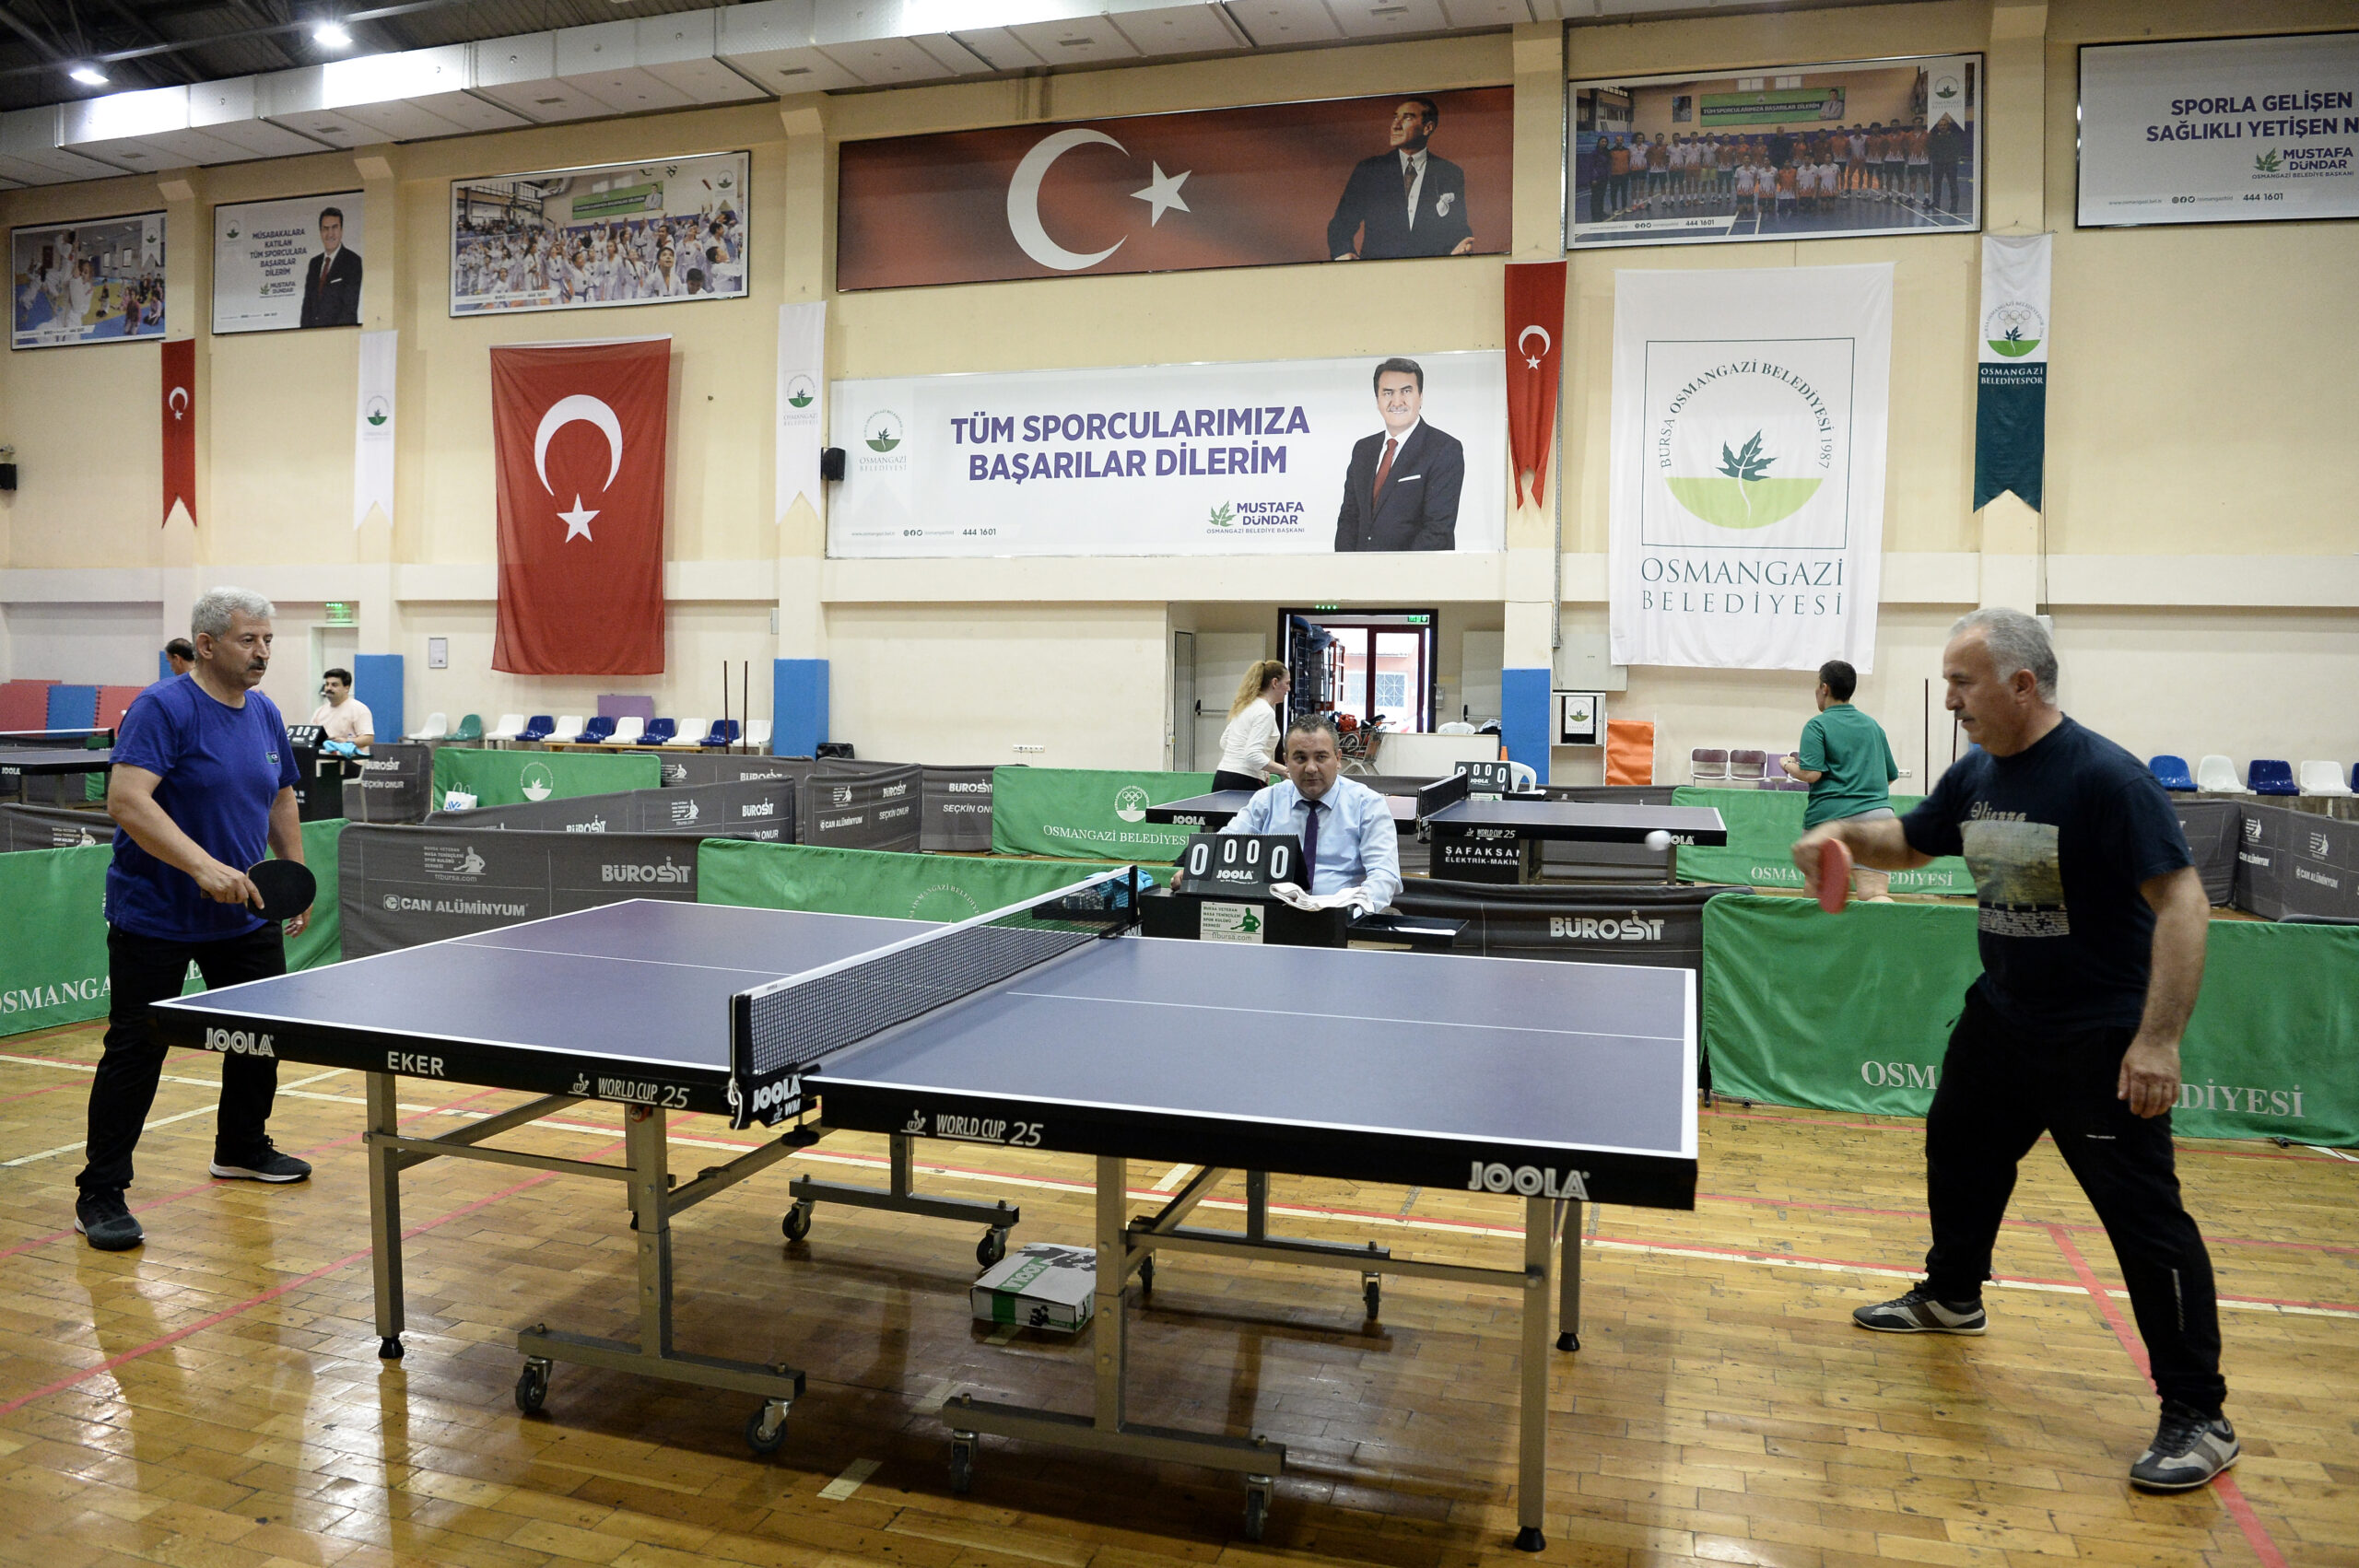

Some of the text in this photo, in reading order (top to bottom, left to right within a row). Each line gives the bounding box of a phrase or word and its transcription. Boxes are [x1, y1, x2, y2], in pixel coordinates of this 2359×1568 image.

[2171, 90, 2353, 115] SPORLA GELİŞEN
[2146, 120, 2241, 142] SAĞLIKLI
[2248, 116, 2338, 138] YETİŞEN
[2283, 147, 2353, 159] MUSTAFA
[2290, 159, 2347, 170] DÜNDAR
[2264, 193, 2283, 201] 1601
[1981, 367, 2043, 375] OSMANGAZİ
[1659, 358, 1835, 469] BURSA OSMANGAZİ BELEDİYESİ 1987
[951, 405, 1310, 445] TÜM SPORCULARIMIZA
[969, 442, 1287, 485] BAŞARILAR DİLERİM
[1237, 502, 1305, 513] MUSTAFA
[1243, 515, 1298, 525] DÜNDAR
[980, 528, 996, 536] 1601
[1641, 556, 1843, 587] OSMANGAZİ
[1642, 590, 1842, 615] BELEDİYESİ
[2, 766, 20, 775] JOOLA
[1473, 764, 1480, 776] 0
[1485, 764, 1492, 776] 0
[1496, 767, 1507, 783] 0
[943, 803, 992, 813] SEÇKİN ON
[1172, 815, 1205, 825] JOOLA
[1043, 825, 1116, 842] OSMANGAZİ
[1504, 829, 1516, 838] 25
[1671, 835, 1695, 846] OLA
[1190, 838, 1289, 879] 0 0 0 0
[1445, 857, 1520, 866] ELEKTRİK-MAKİN
[1216, 869, 1253, 880] JOOLA
[1888, 870, 1954, 886] EDİYESİ
[400, 897, 525, 917] CAN ALÜMİNYUM
[1212, 932, 1252, 942] ttbursa.com
[0, 975, 111, 1014] SMANGA
[205, 1027, 275, 1058] JOOLA
[387, 1051, 444, 1077] EKER
[598, 1077, 690, 1108] WORLD CUP 25
[752, 1074, 801, 1113] JOOLA
[2179, 1078, 2305, 1118] DİYESİ
[785, 1098, 801, 1116] WM
[936, 1113, 1044, 1147] WORLD CUP 25
[1468, 1161, 1590, 1201] JOOLA
